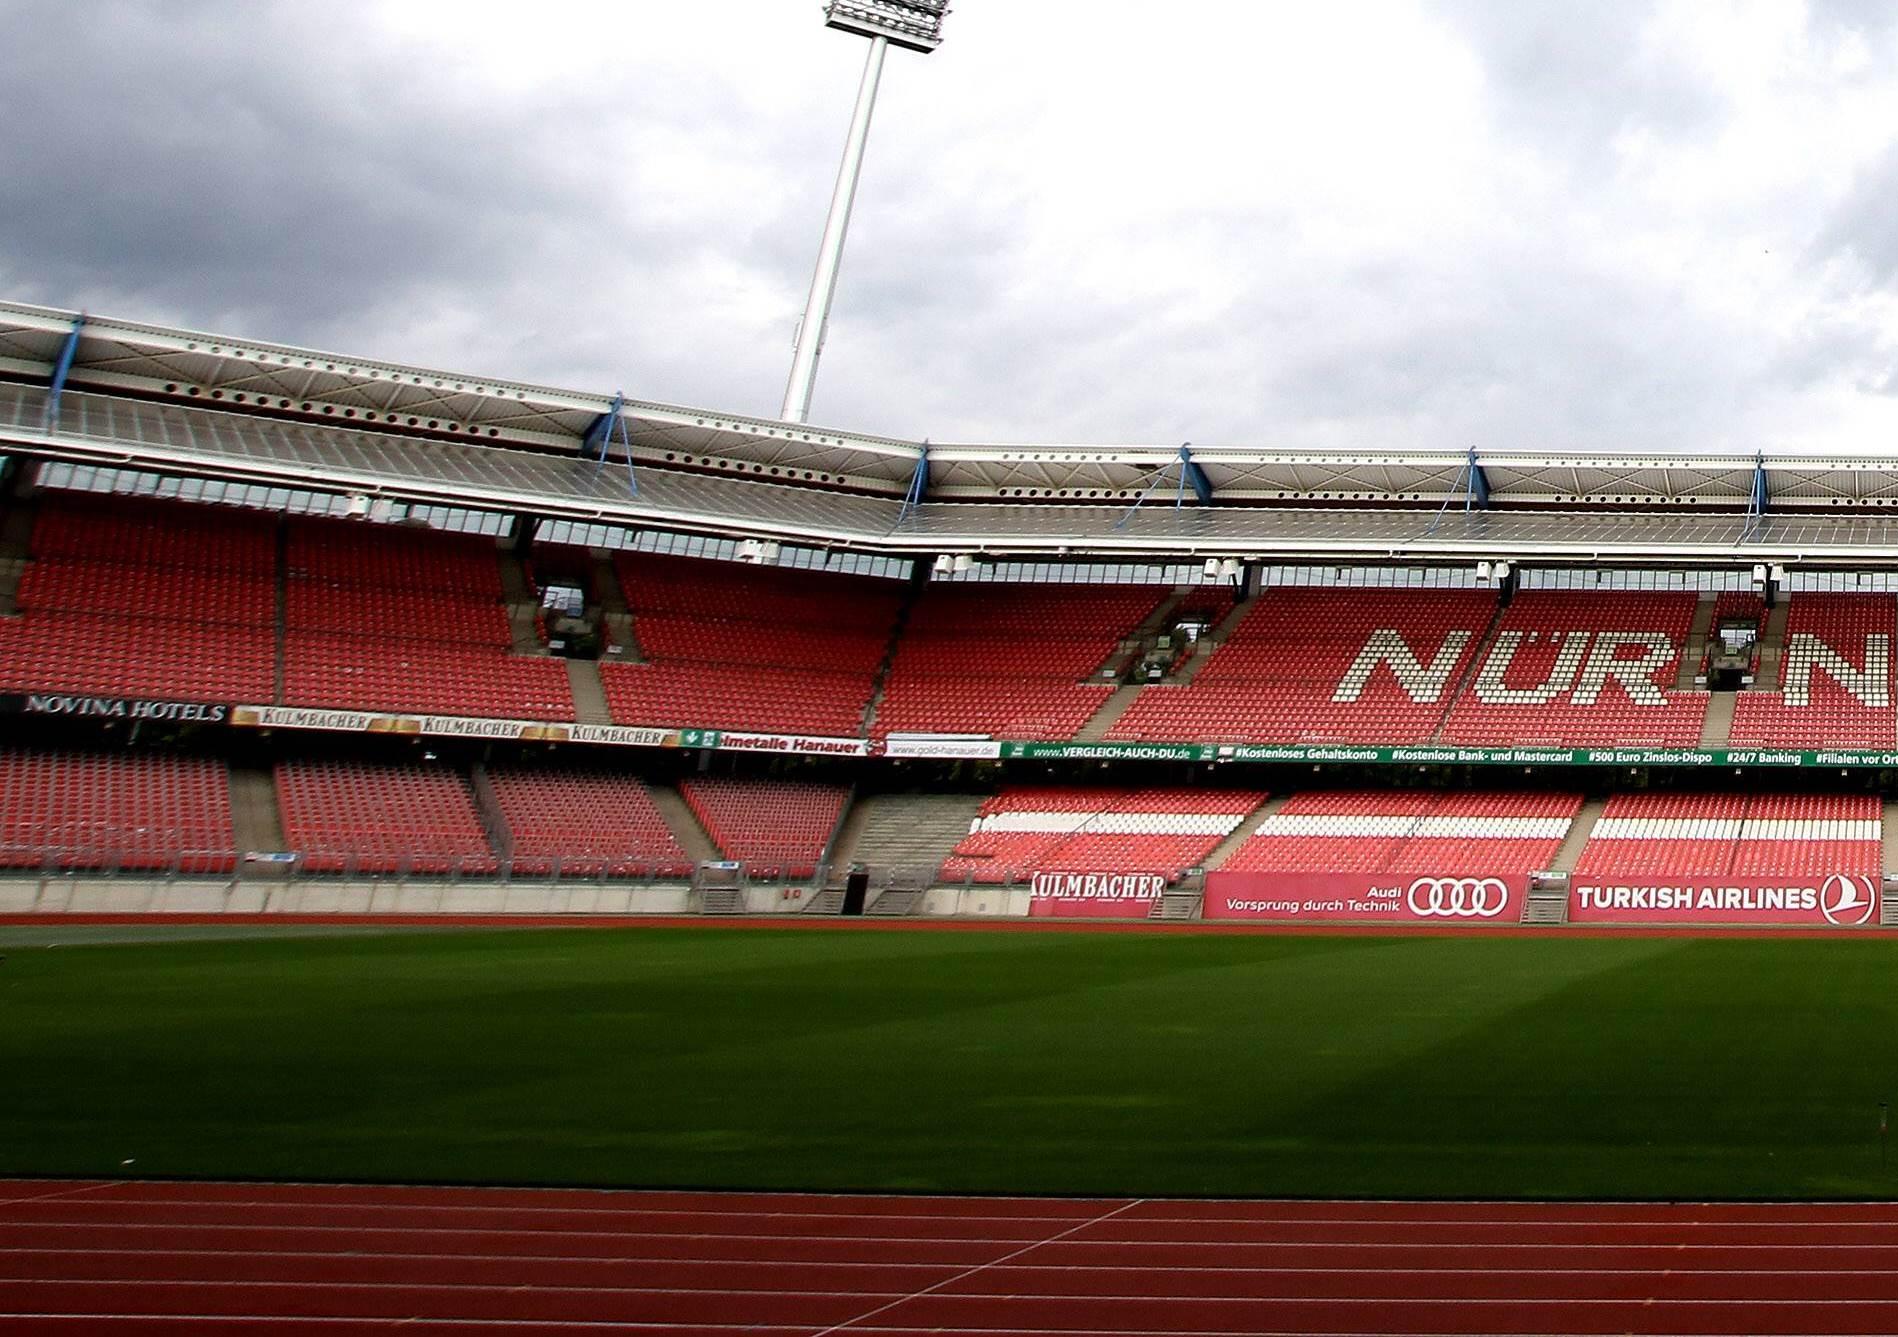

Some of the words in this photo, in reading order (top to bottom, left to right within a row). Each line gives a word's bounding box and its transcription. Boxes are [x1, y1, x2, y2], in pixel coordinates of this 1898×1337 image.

[24, 695, 127, 717] NOVINA
[130, 702, 227, 722] HOTELS
[260, 707, 367, 730] KULMBACHER
[421, 716, 521, 738] KULMBACHER
[570, 725, 662, 745] KULMBACHER
[720, 736, 788, 752] lmetalle
[792, 738, 860, 755] Hanauer
[1033, 746, 1190, 760] www.VERGLEICH-AUCH-DU.de
[1235, 748, 1304, 760] #Kostenloses
[1306, 748, 1378, 760] Gehaltskonto
[1392, 749, 1455, 761] #Kostenlose
[1457, 750, 1490, 763] Bank-
[1491, 750, 1511, 762] und
[1514, 750, 1573, 762] Mastercard
[1589, 751, 1612, 762] #500
[1615, 751, 1639, 762] Euro
[1642, 751, 1712, 766] Zinslos-Dispo
[1726, 751, 1755, 763] #24/7
[1758, 751, 1801, 766] Banking
[1816, 751, 1859, 765] #Filialen
[1862, 754, 1879, 764] vor
[1367, 886, 1402, 898] Audi
[1577, 887, 1693, 909] TURKISH
[1696, 887, 1817, 910] AIRLINES
[1226, 898, 1300, 914] Vorsprung
[1302, 898, 1344, 911] durch
[1347, 898, 1400, 912] Technik
